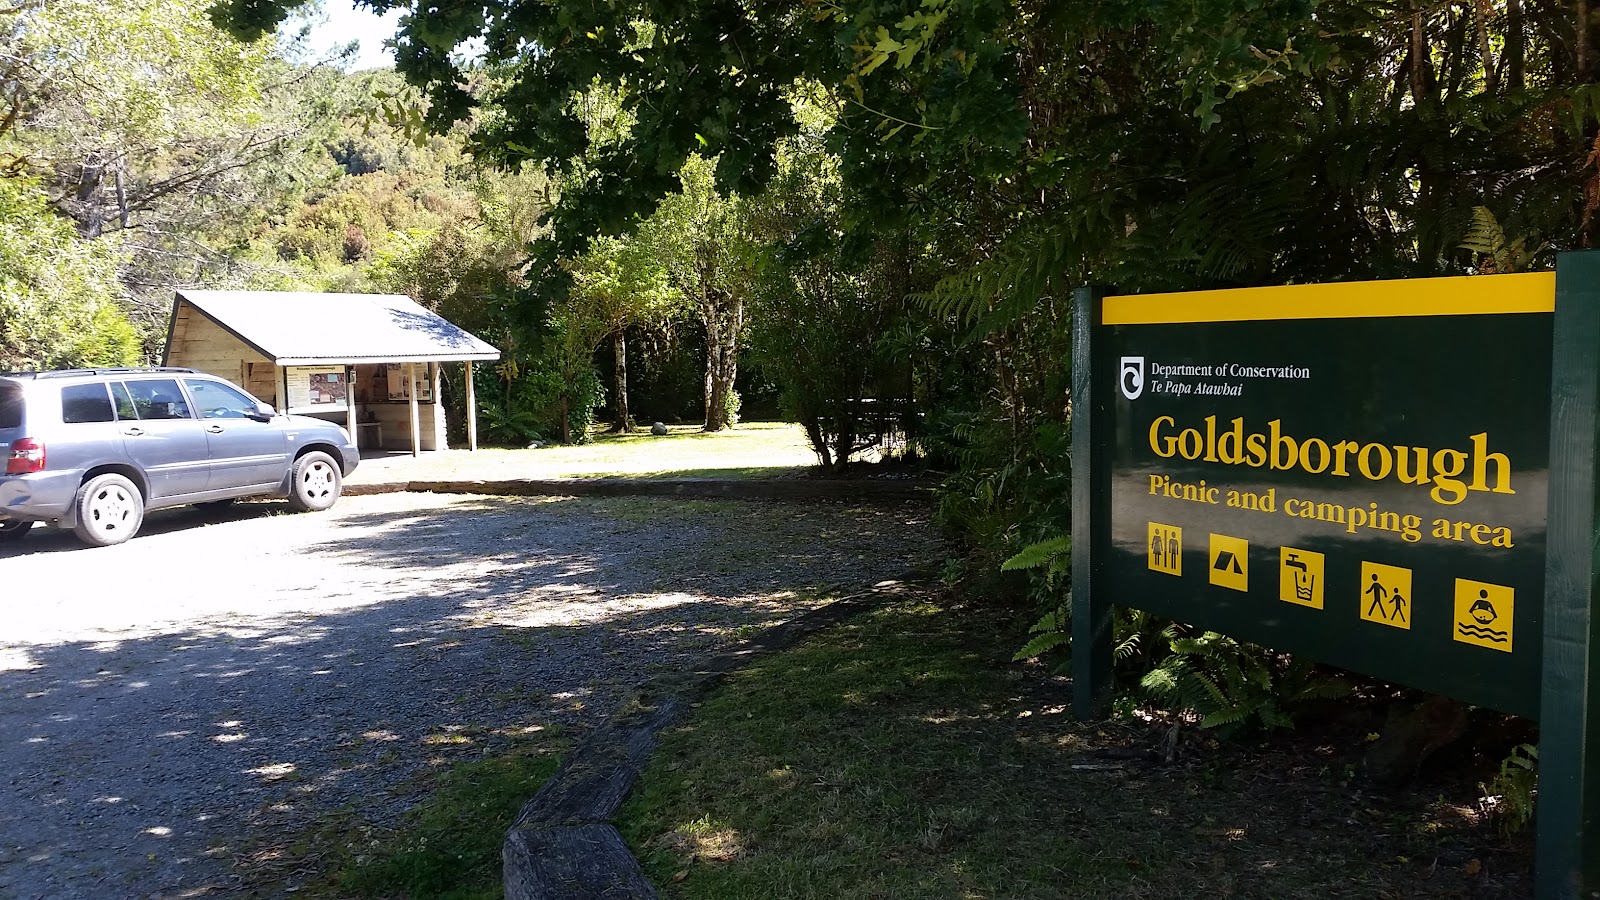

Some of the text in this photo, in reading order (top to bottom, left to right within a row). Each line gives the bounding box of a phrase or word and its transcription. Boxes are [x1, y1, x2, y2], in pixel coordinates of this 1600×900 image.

[1151, 362, 1311, 379] Department of Conservation
[1151, 380, 1243, 396] Te Papa Atawhai
[1149, 414, 1516, 505] Goldsborough
[1149, 474, 1514, 549] Picnic and camping area
